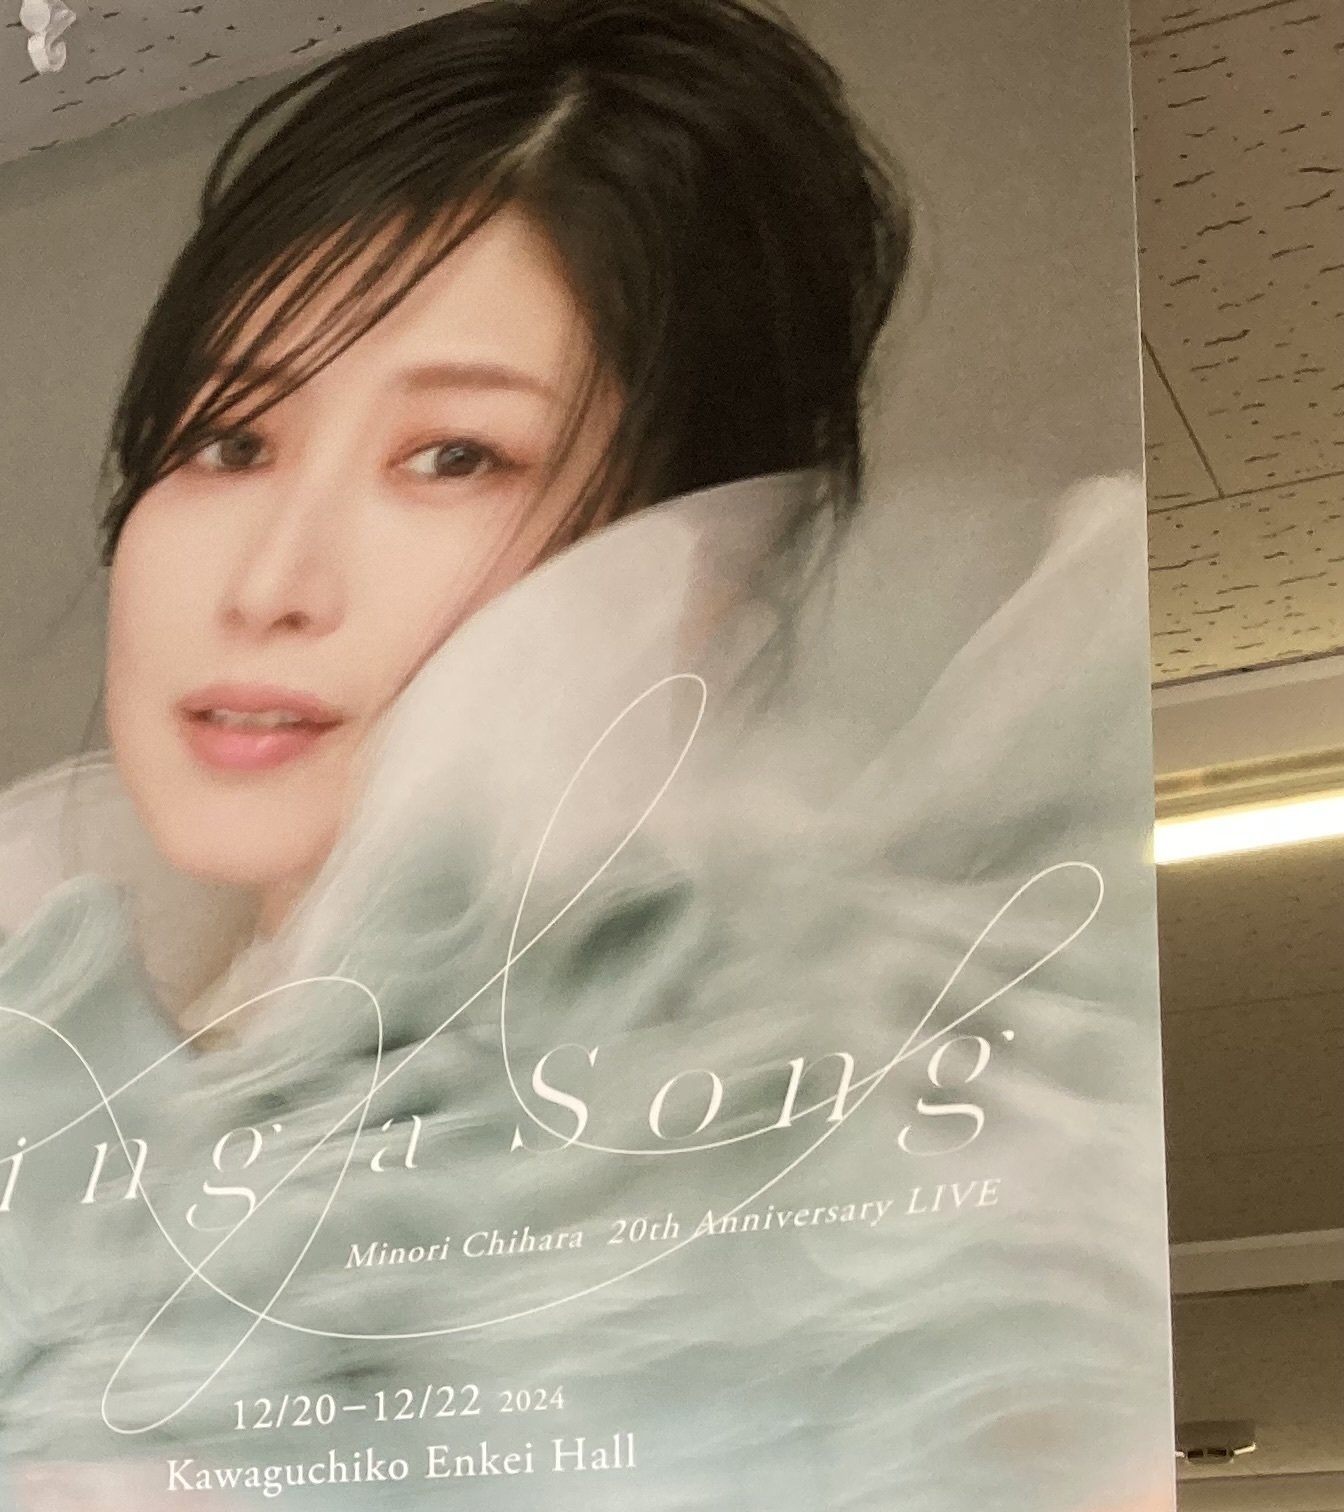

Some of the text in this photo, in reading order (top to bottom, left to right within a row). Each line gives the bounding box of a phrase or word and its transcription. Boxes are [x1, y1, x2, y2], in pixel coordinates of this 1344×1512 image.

[370, 1115, 422, 1173] a
[511, 1029, 1015, 1156] Song
[344, 1178, 1002, 1269] Minori Chihara 20th Anniversary LIVE
[498, 1386, 566, 1413] 2024
[166, 1432, 637, 1498] Kawaguchiko Enkei Hall
